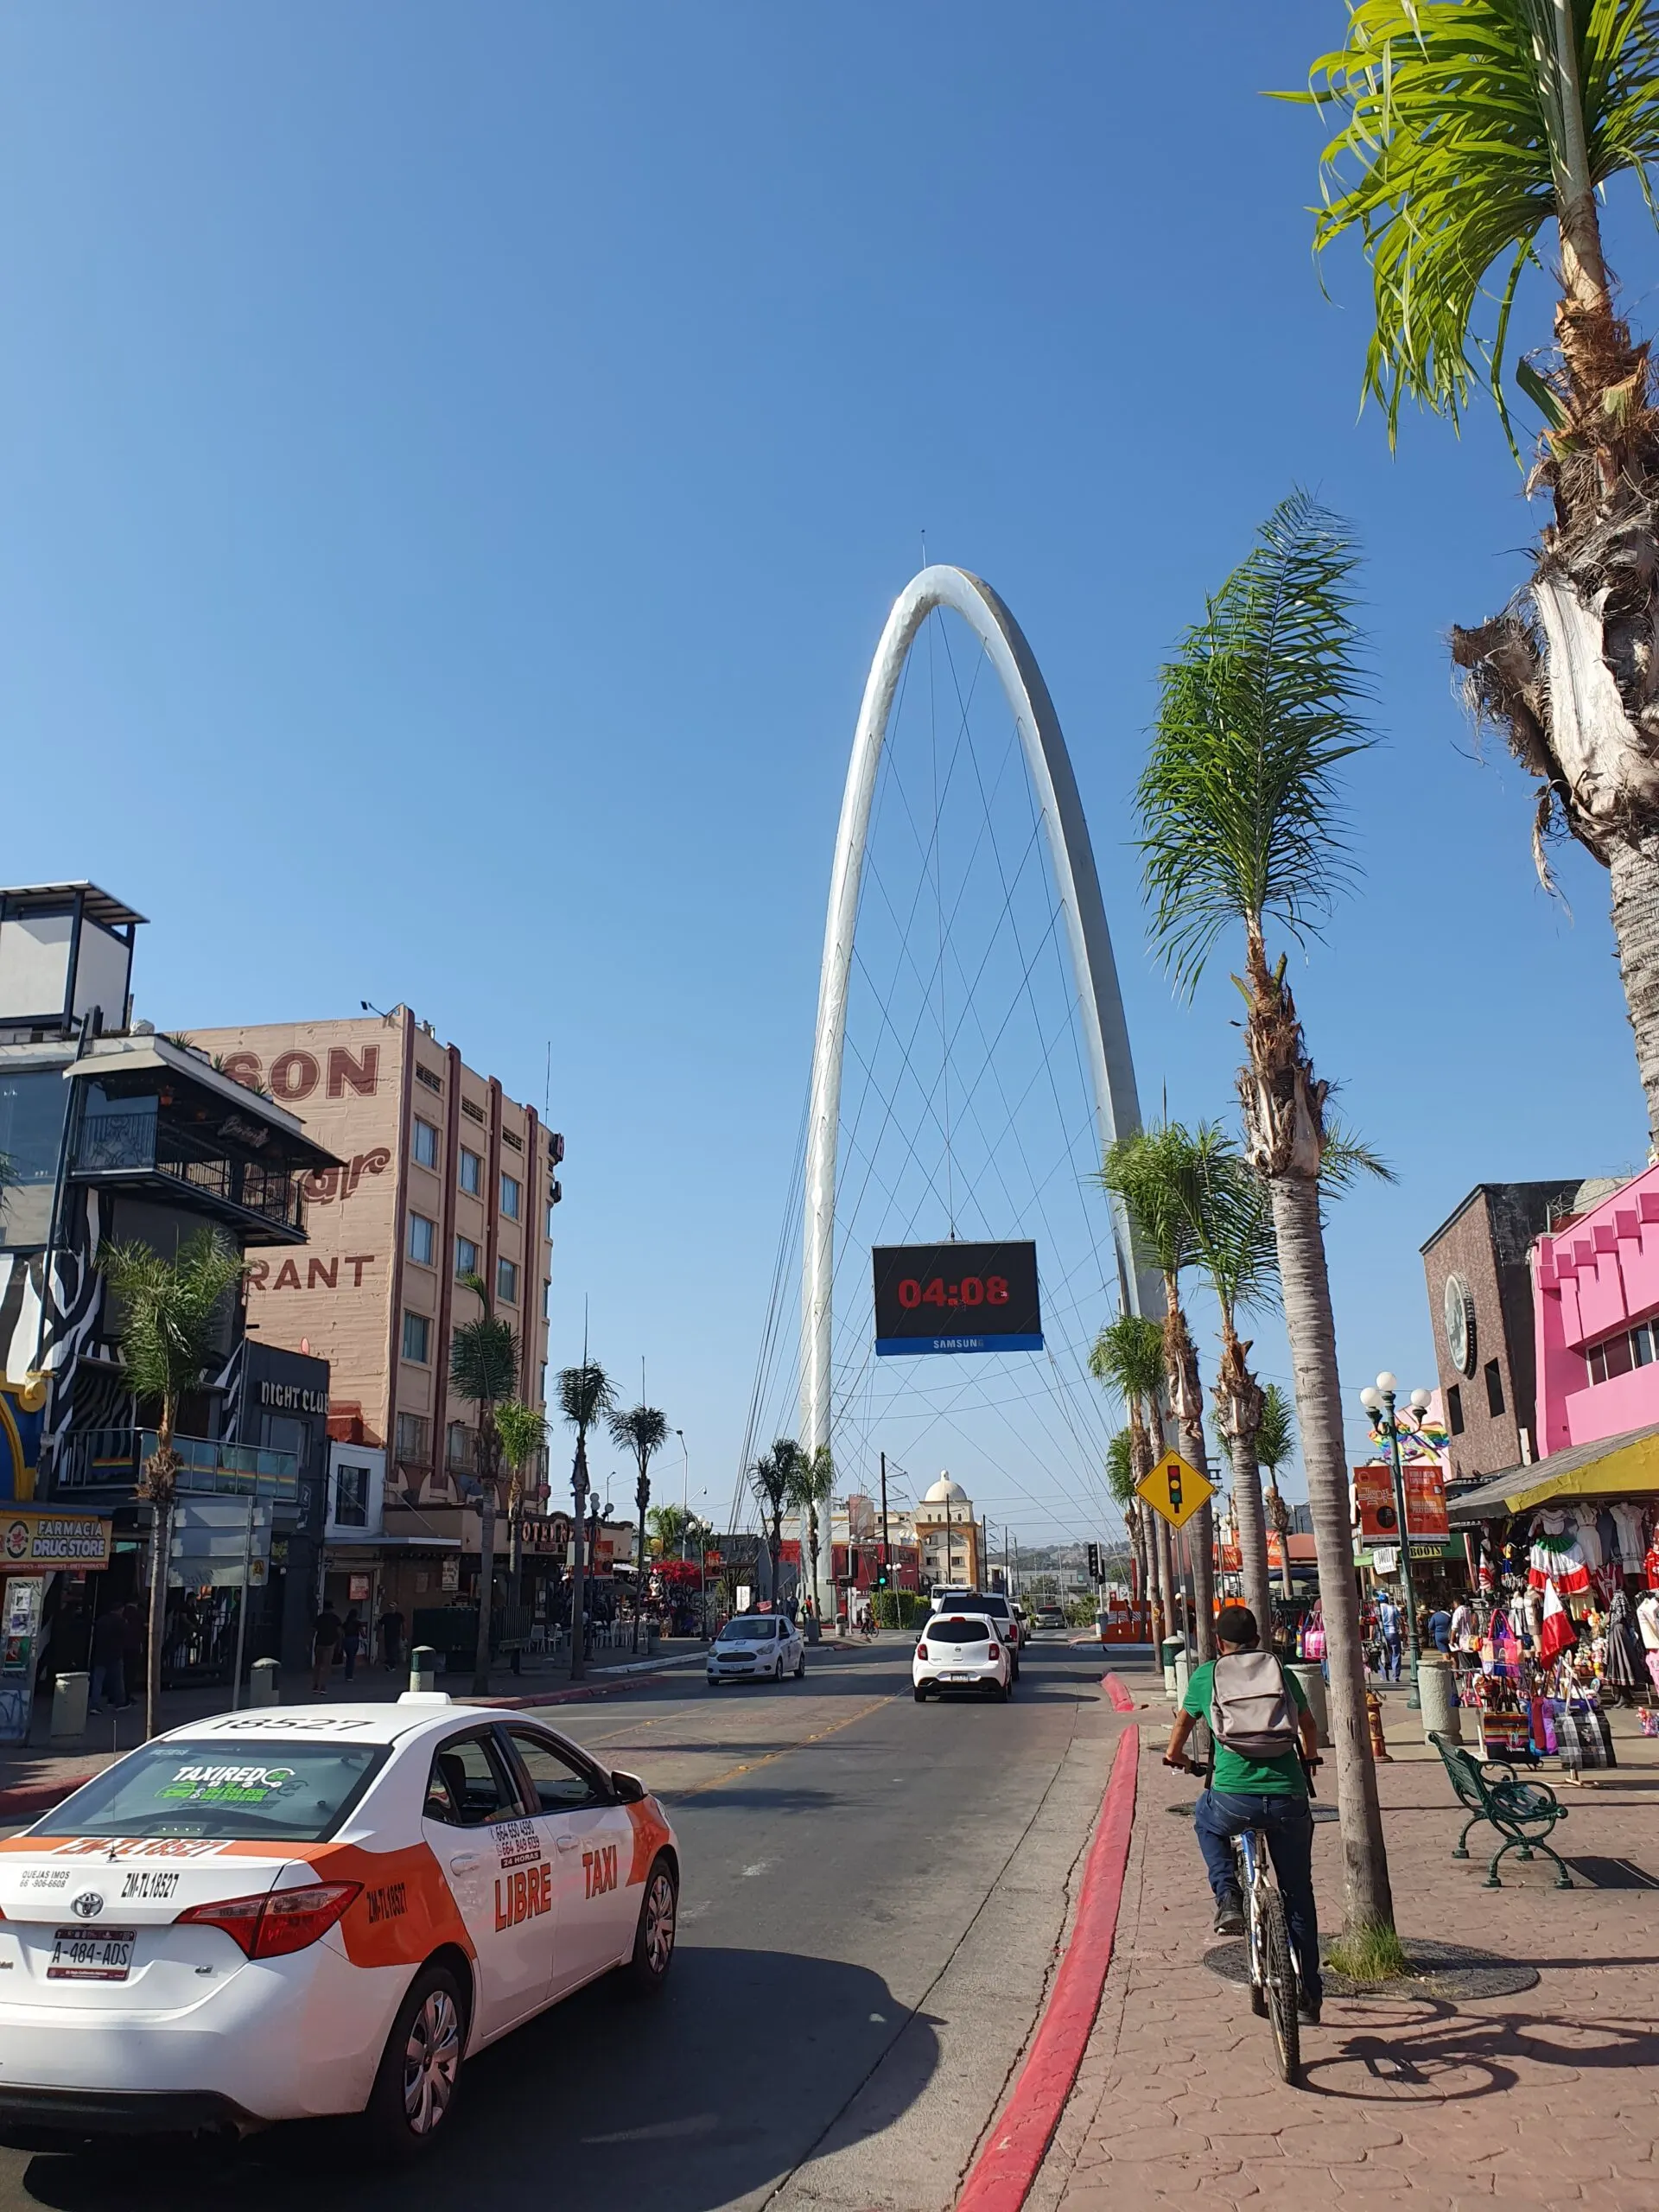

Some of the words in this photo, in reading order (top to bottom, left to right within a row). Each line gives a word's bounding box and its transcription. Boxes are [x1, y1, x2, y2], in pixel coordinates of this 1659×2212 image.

[898, 1275, 1009, 1308] 04:08
[933, 1338, 984, 1350] SAMSUNG
[261, 1381, 302, 1409] NIGHT
[38, 1520, 103, 1536] FARMACIA
[32, 1538, 68, 1557] DRUG
[68, 1538, 105, 1557] STORE
[1409, 1545, 1441, 1557] BOOTS
[211, 1718, 376, 1732] 18527
[172, 1766, 267, 1782] TAXIRED
[503, 1859, 513, 1867] 24
[514, 1852, 539, 1864] HORAS
[22, 1870, 50, 1879] QUEJAS
[582, 1844, 618, 1900] TAXI
[121, 1872, 180, 1898] ZM-TL18527
[495, 1862, 552, 1933] LIBRE
[52, 1941, 130, 1966] A-484-ADS
